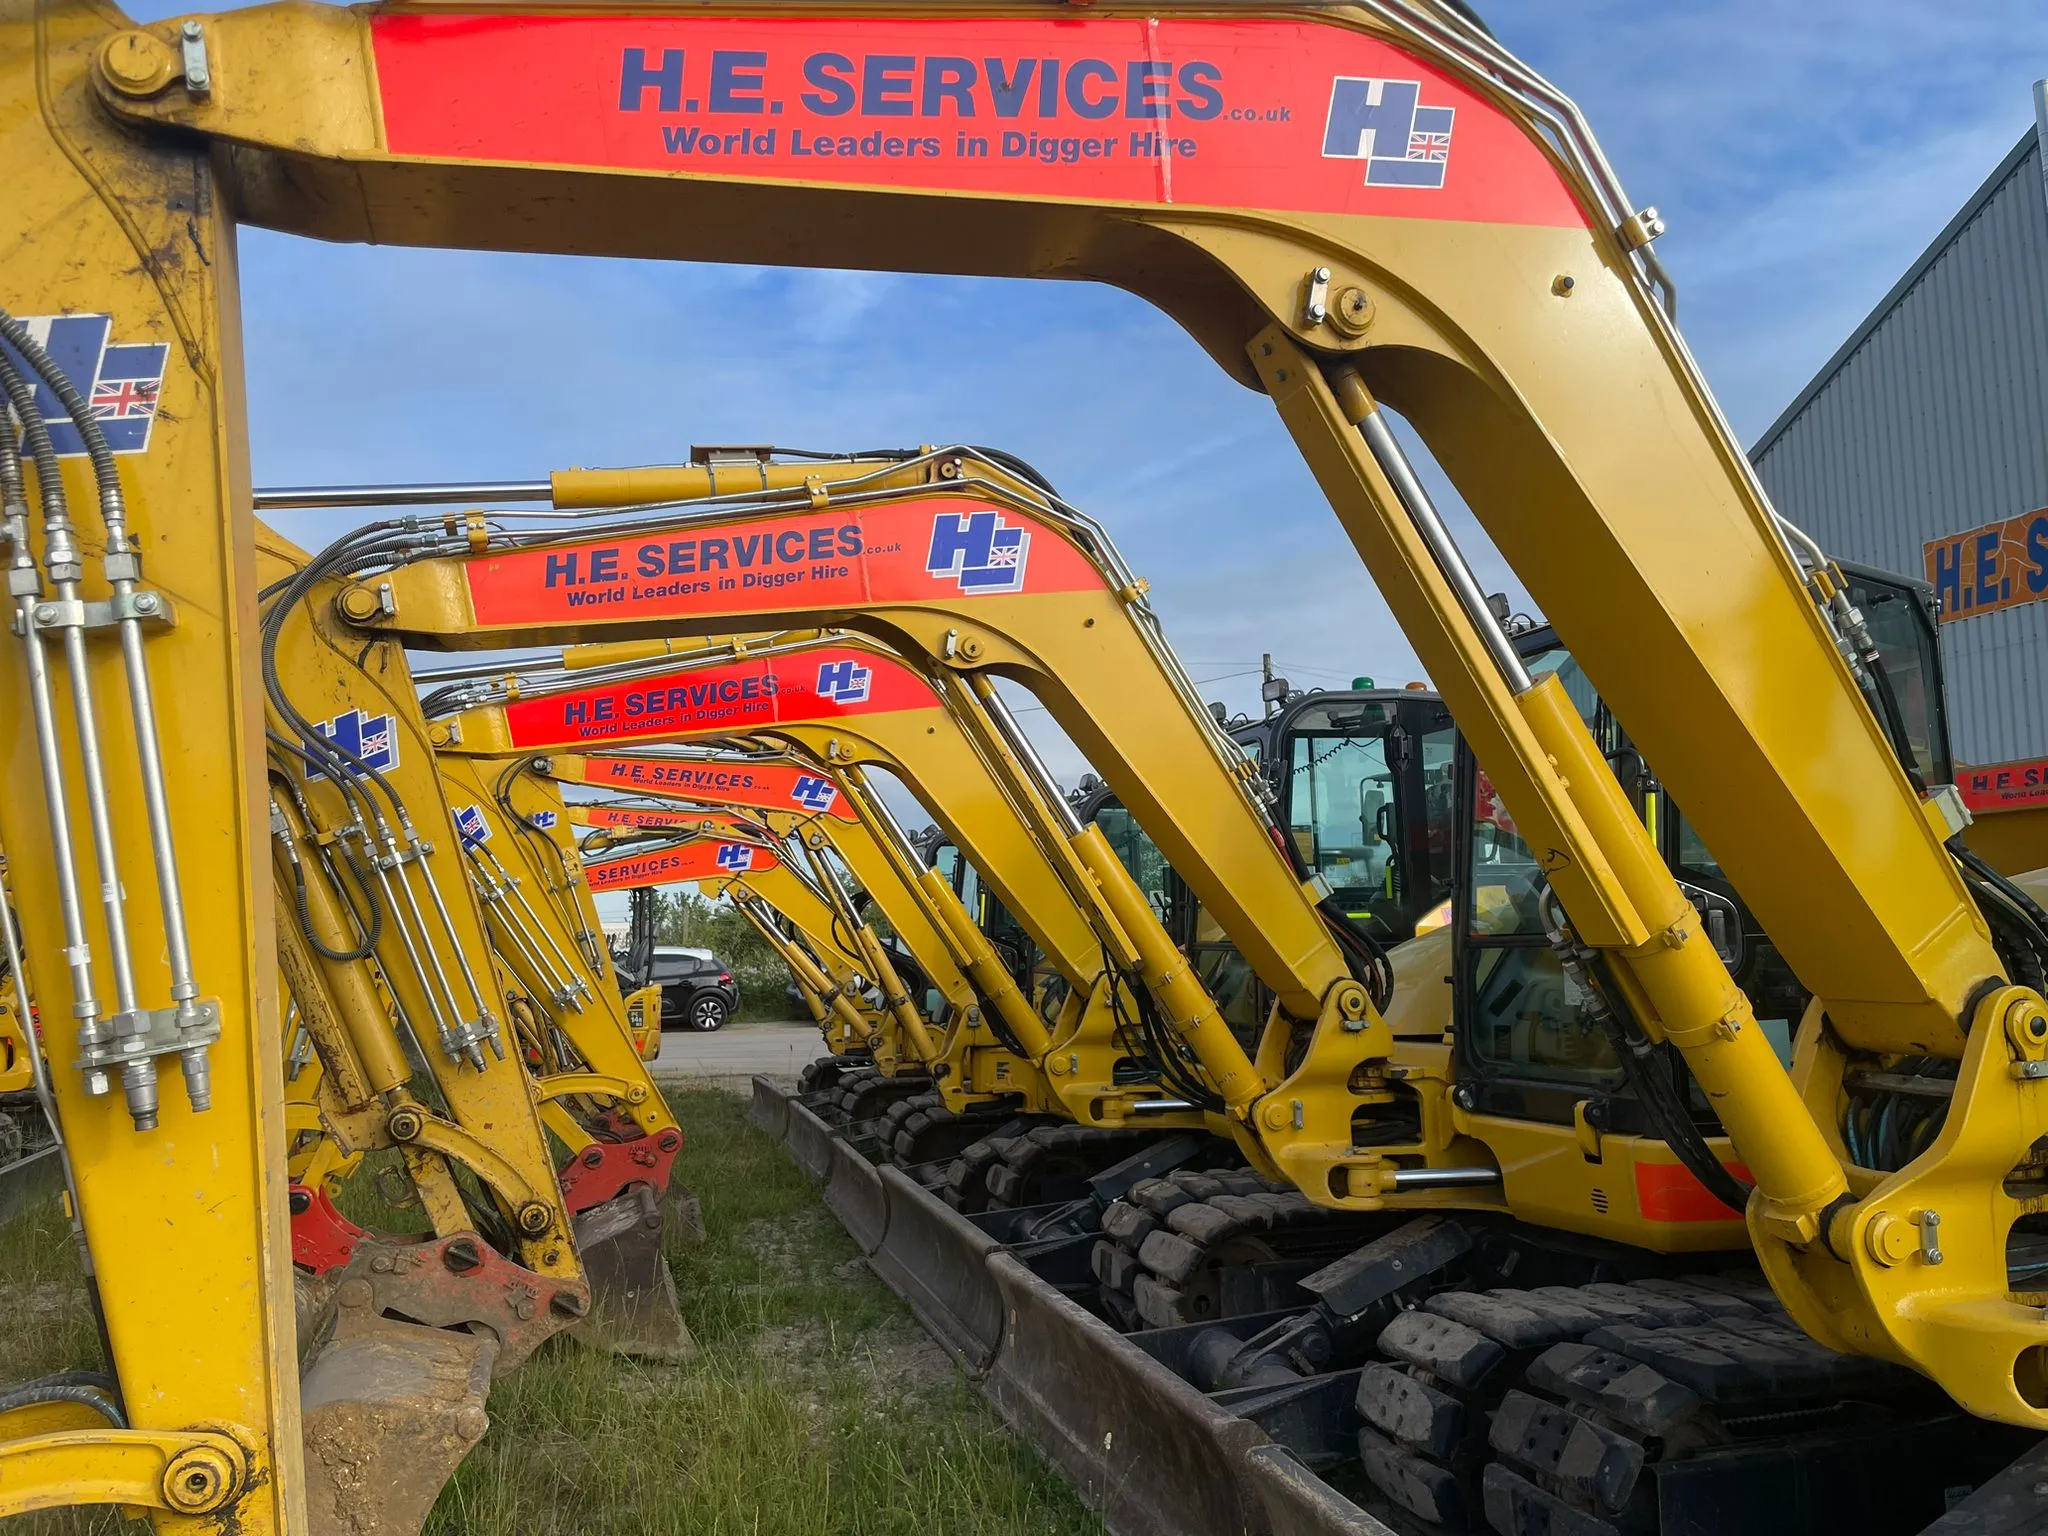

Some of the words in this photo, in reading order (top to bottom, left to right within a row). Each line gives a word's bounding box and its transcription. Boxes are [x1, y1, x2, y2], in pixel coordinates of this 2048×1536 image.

[618, 48, 784, 115] H.E.
[661, 126, 776, 155] World
[791, 129, 941, 157] Leaders
[956, 131, 988, 157] in
[1002, 131, 1119, 164] Digger
[1129, 132, 1197, 157] Hire
[545, 548, 629, 588] H.E.
[567, 587, 625, 607] World
[632, 581, 710, 600] Leaders
[718, 577, 736, 590] in
[743, 569, 805, 588] Digger
[811, 565, 849, 580] Hire
[1936, 531, 2011, 615] H.E.
[565, 697, 619, 726] H.E.
[580, 723, 617, 737] World
[622, 717, 674, 731] Leaders
[680, 711, 692, 722] in
[696, 706, 739, 721] Digger
[743, 702, 769, 713] Hire
[611, 763, 645, 778] H.E.
[633, 777, 654, 785] World
[654, 779, 682, 788] Leaders
[692, 783, 716, 791] Digger
